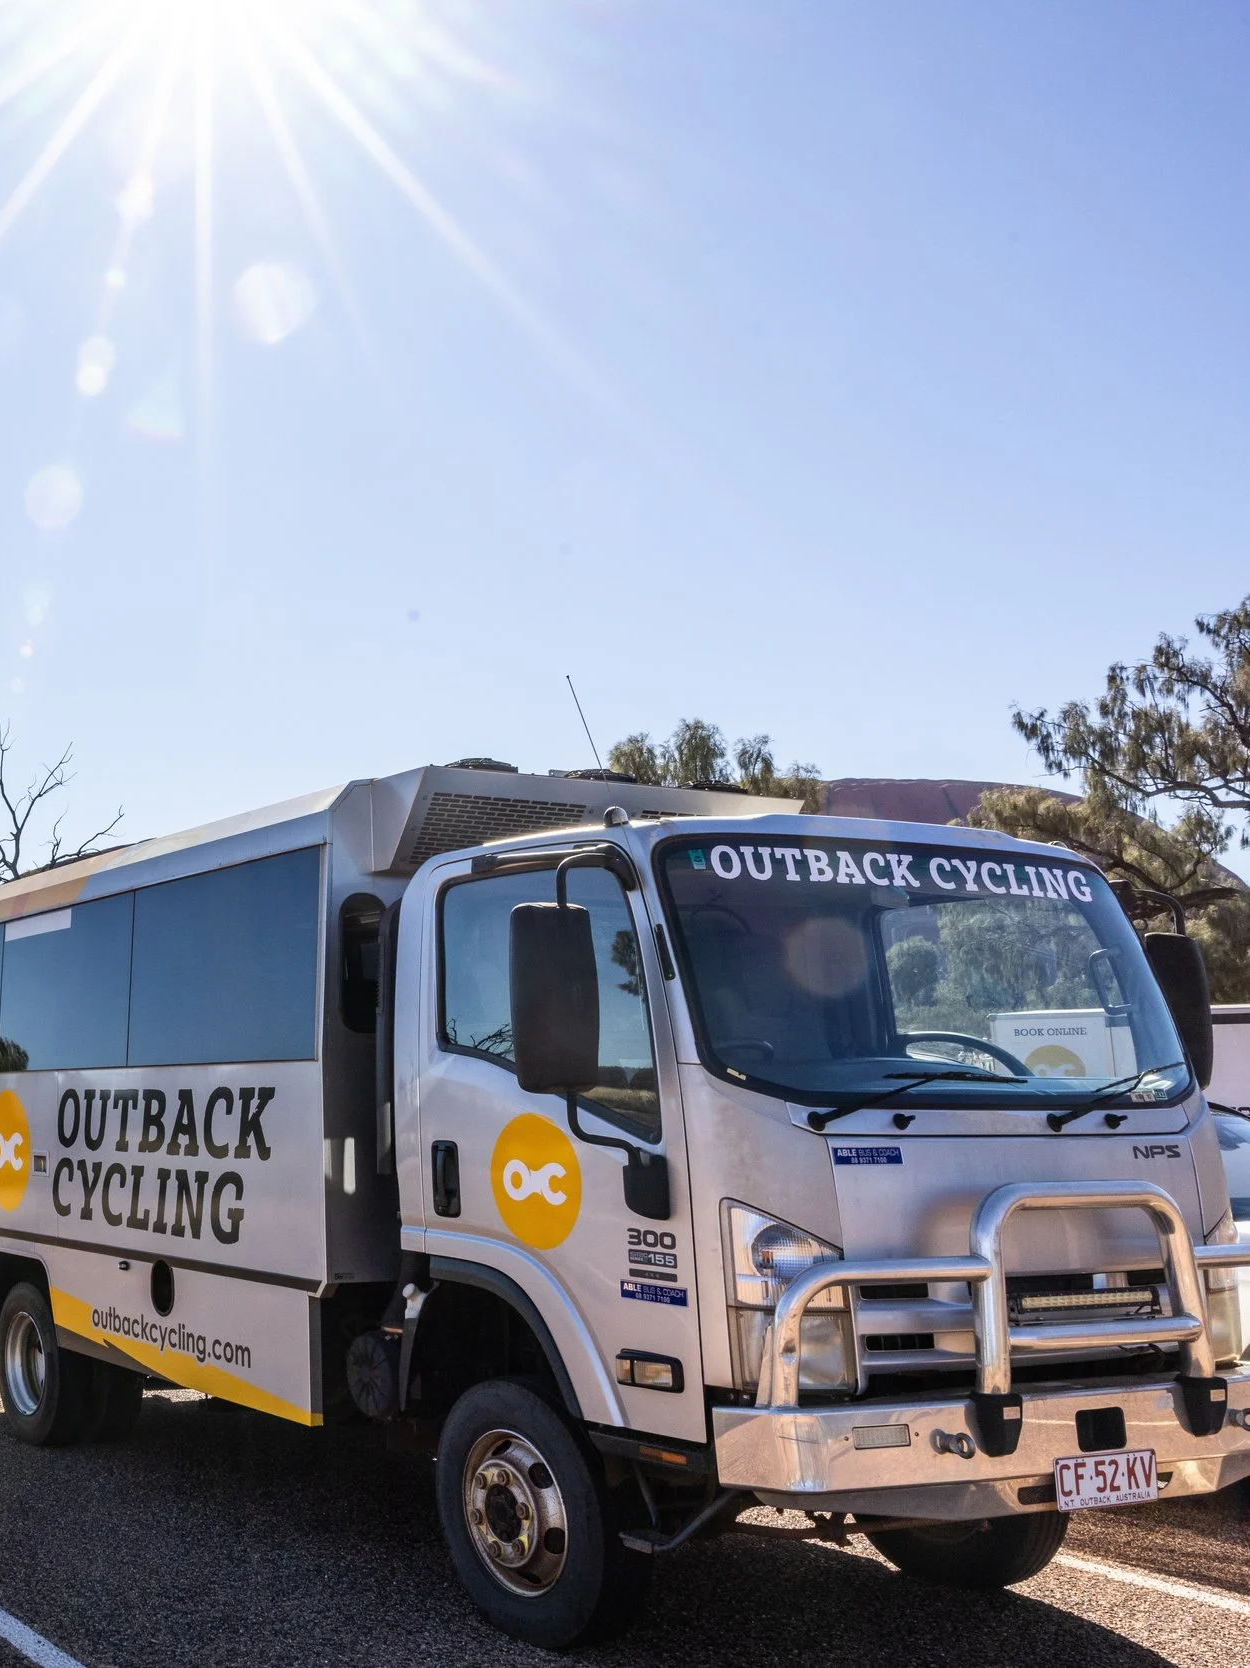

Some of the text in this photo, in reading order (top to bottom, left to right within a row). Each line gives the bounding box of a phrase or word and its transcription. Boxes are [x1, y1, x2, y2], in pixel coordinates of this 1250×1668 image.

[710, 844, 1093, 902] OUTBACK CYCLING
[1013, 1027, 1087, 1037] BOOK ONLINE
[57, 1086, 276, 1161] OUTBACK
[1132, 1144, 1181, 1159] NPS
[52, 1157, 245, 1245] CYCLING
[627, 1228, 676, 1250] 300
[648, 1253, 675, 1266] 155
[623, 1282, 684, 1298] ABLE BUS & COACH
[657, 1295, 671, 1303] 7100
[92, 1306, 252, 1368] outbackcycling.com
[1080, 1496, 1112, 1506] OUTBACK
[1116, 1491, 1151, 1501] AUSTRALIA
